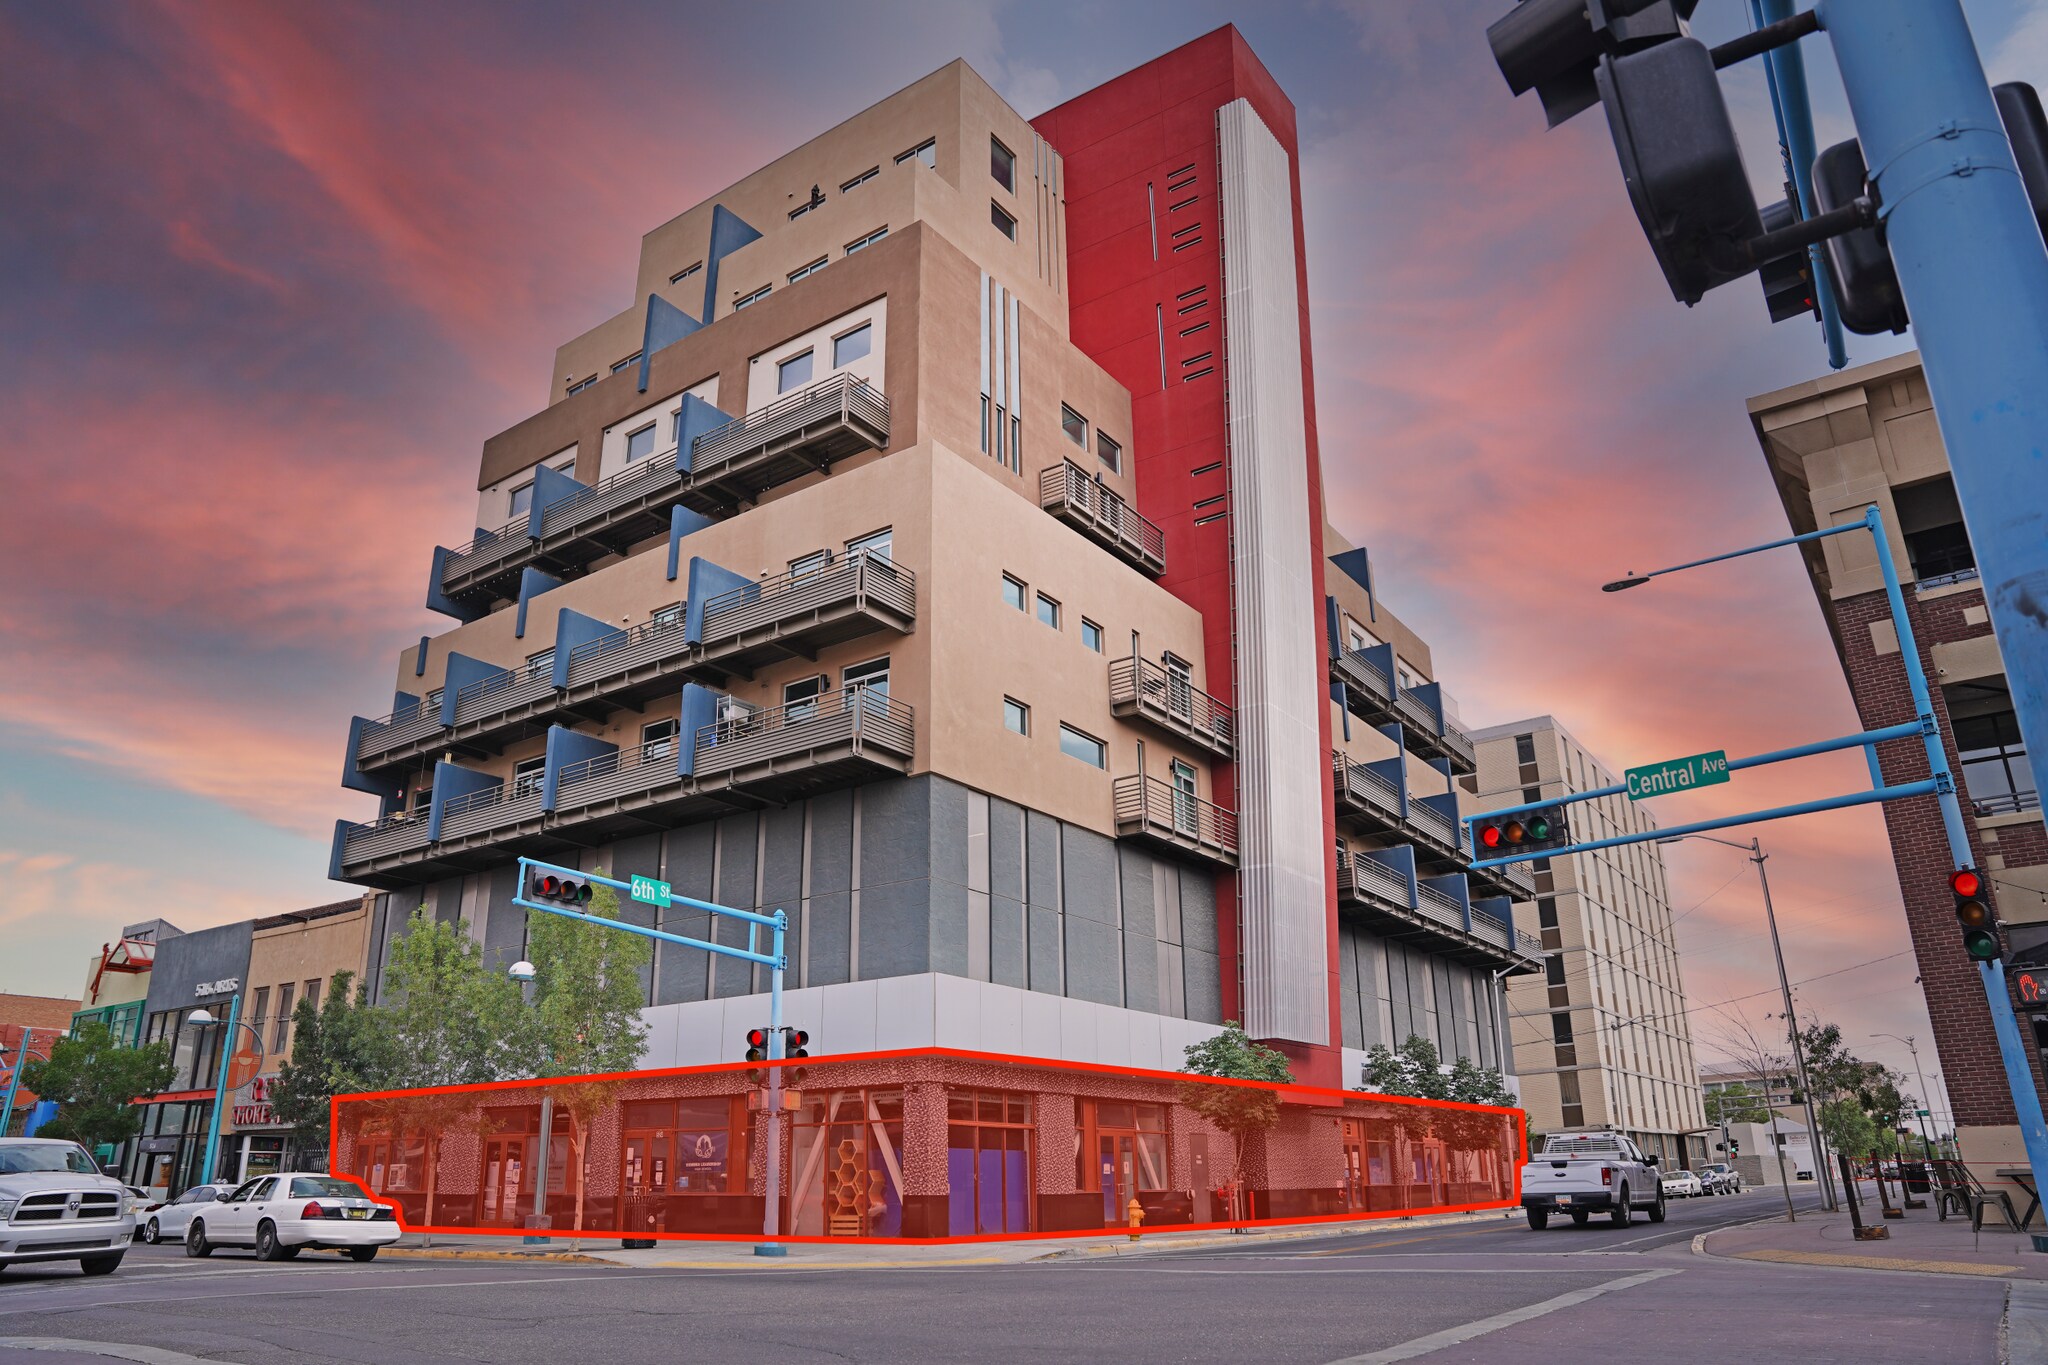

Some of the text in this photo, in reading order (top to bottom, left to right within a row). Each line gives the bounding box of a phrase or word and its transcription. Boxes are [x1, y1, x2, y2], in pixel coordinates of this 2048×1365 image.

[1627, 758, 1726, 796] Central Ave
[632, 879, 670, 901] 6th St
[213, 978, 239, 994] ARTS
[232, 1103, 272, 1126] SMOKE
